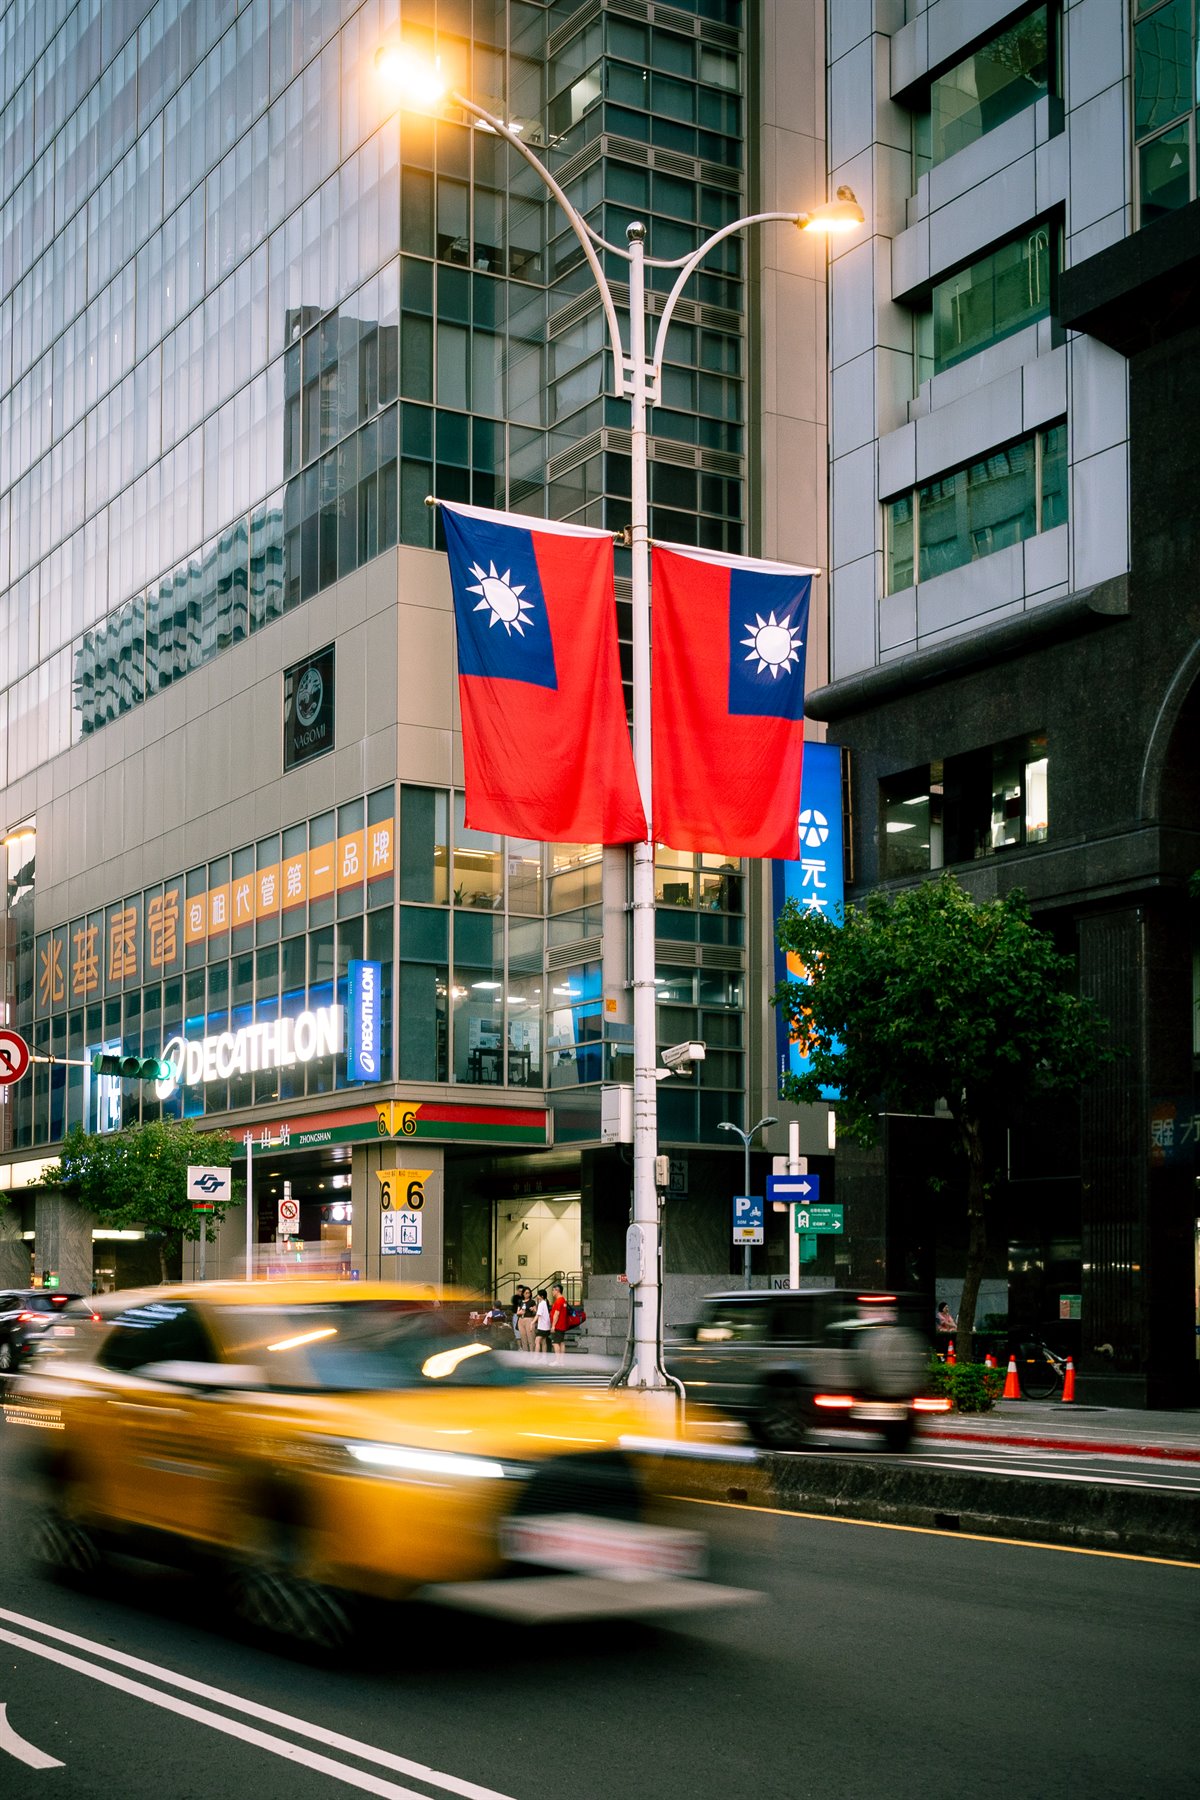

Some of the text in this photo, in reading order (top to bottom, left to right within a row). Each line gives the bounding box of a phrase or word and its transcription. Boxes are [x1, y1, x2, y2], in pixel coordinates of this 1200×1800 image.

[293, 723, 326, 749] NAGOMI
[189, 830, 390, 932] 包租代管第一品牌
[39, 887, 180, 1007] 兆基屋管
[362, 966, 374, 1052] DECATHLON
[184, 1003, 343, 1086] DECATHLON
[378, 1112, 387, 1135] 6
[402, 1111, 416, 1134] 6
[299, 1132, 332, 1144] ZHONGSHAN
[381, 1181, 391, 1210] 6
[406, 1181, 424, 1210] 6
[735, 1198, 751, 1217] P
